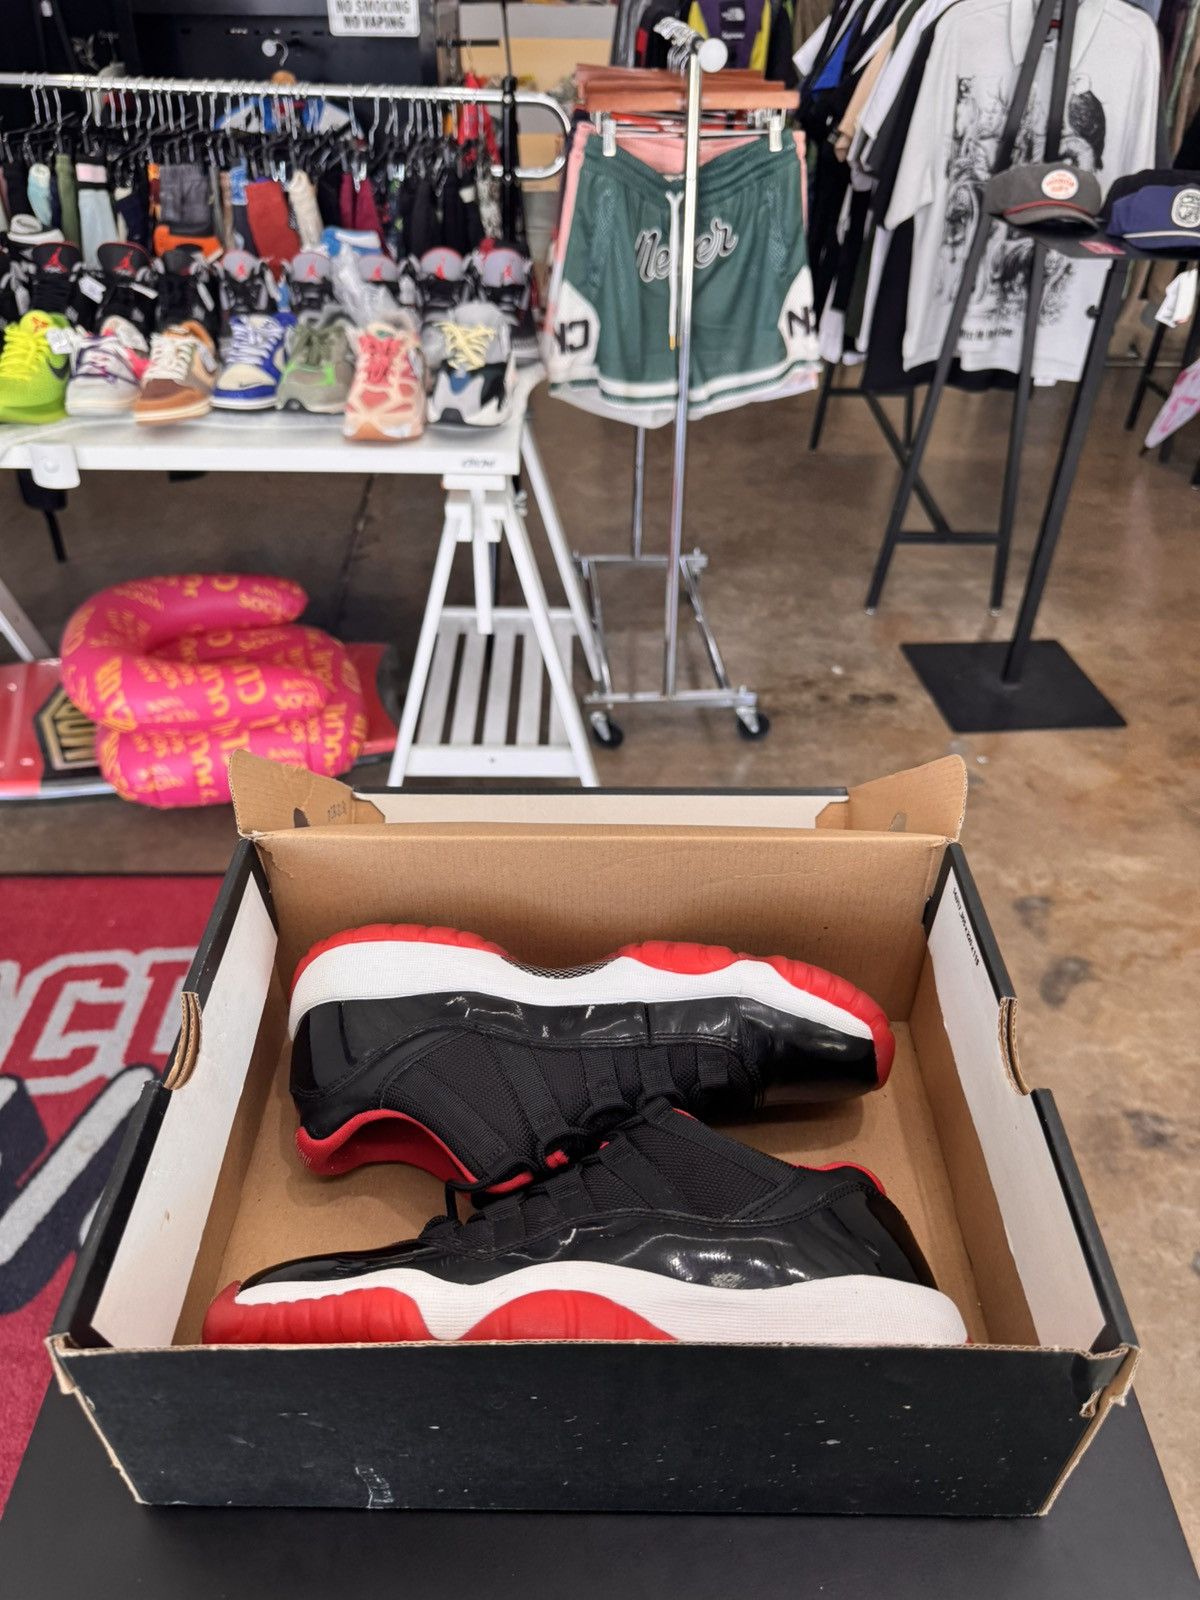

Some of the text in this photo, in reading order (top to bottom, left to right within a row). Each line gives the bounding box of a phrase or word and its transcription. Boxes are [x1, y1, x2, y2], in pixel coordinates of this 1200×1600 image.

[336, 0, 410, 13] NO SMOKING
[343, 15, 406, 29] NO VAPING
[635, 217, 738, 283] Neer
